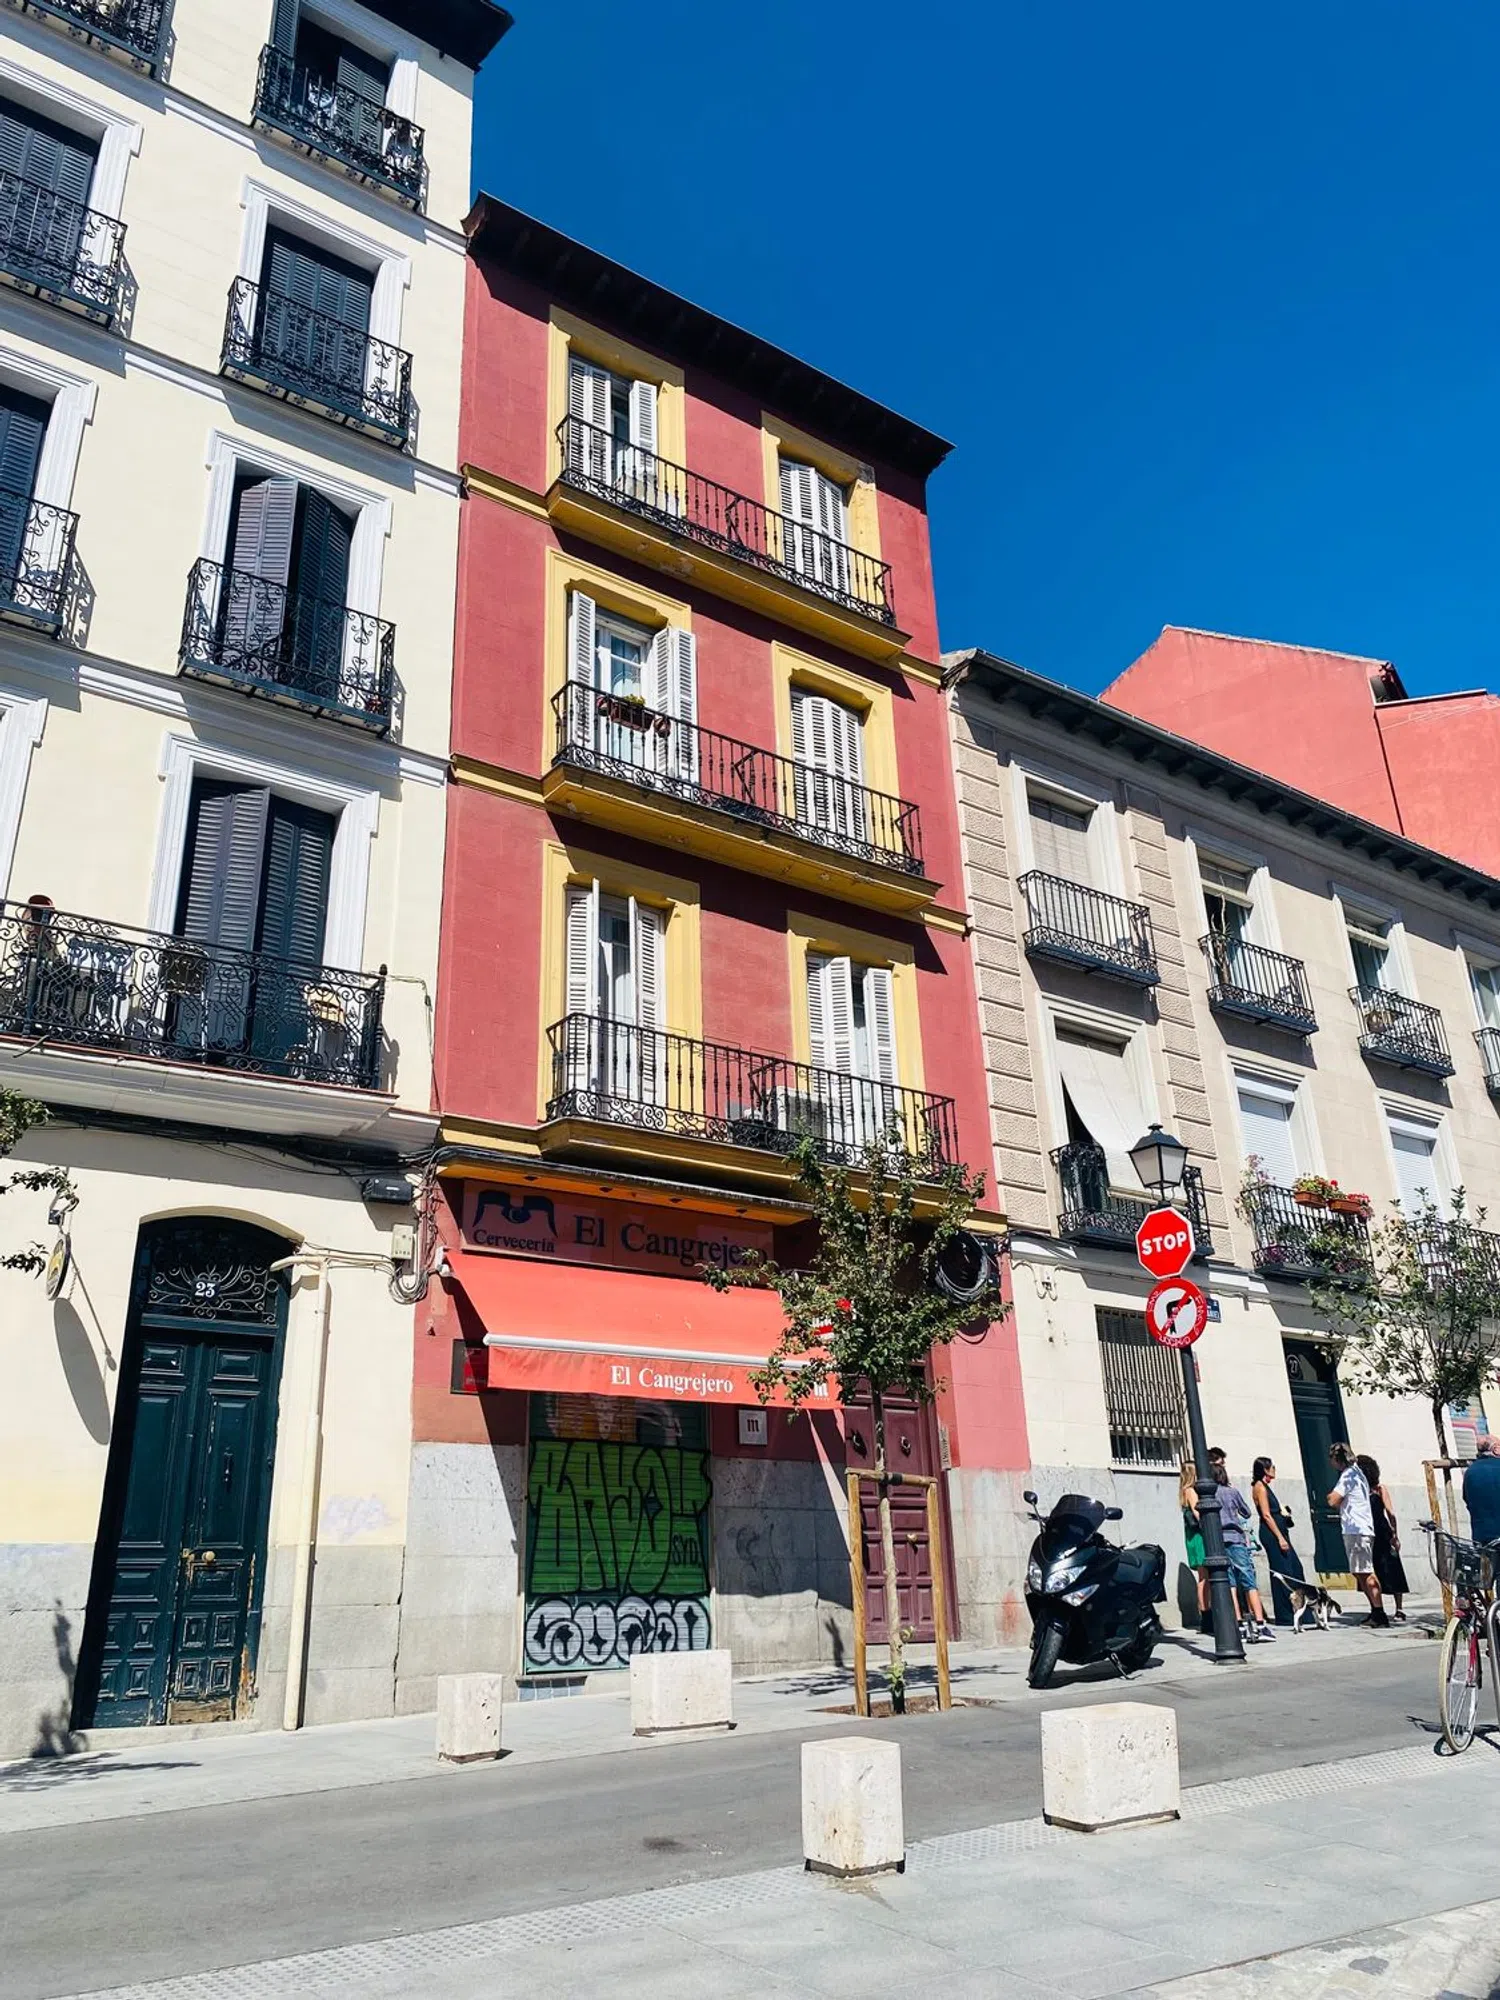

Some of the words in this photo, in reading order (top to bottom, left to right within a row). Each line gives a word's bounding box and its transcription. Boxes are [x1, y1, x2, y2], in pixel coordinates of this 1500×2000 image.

[572, 1214, 605, 1247] El
[620, 1221, 767, 1271] Cangrejero
[1141, 1231, 1187, 1256] STOP
[194, 1281, 216, 1298] 23
[610, 1365, 631, 1386] El
[638, 1367, 734, 1396] Cangrejero
